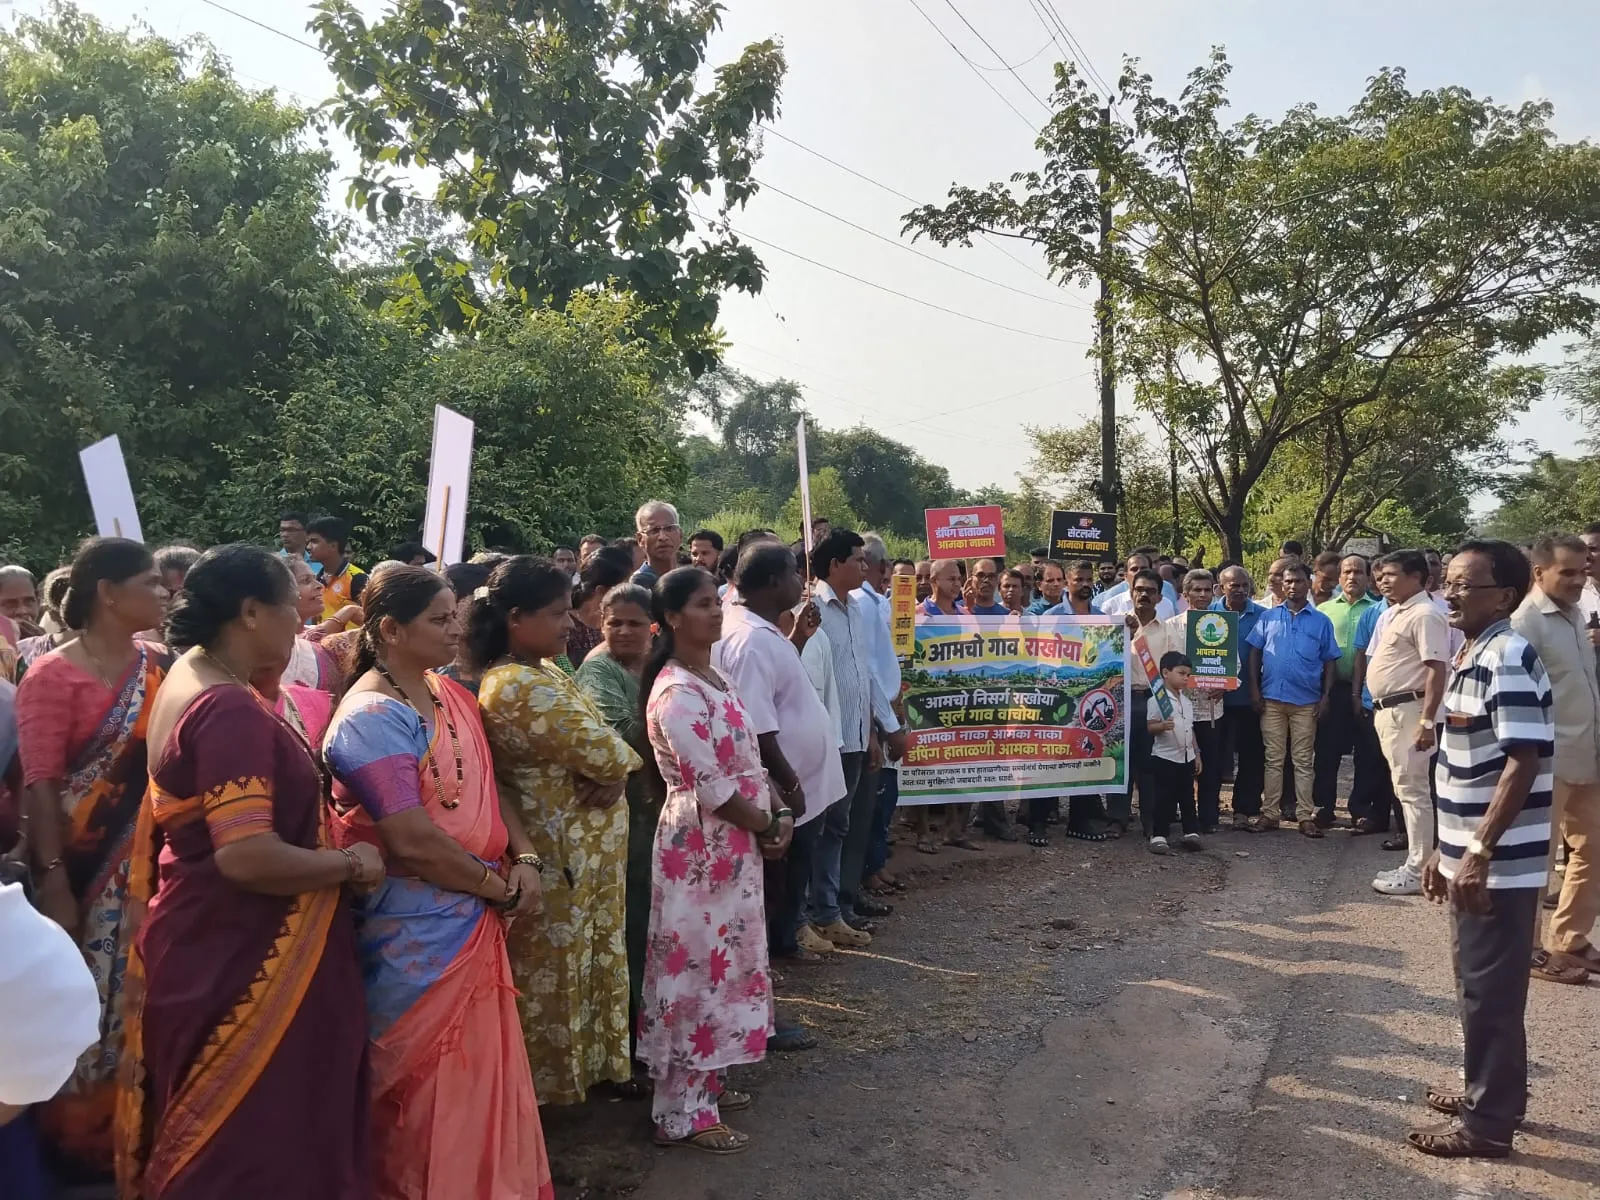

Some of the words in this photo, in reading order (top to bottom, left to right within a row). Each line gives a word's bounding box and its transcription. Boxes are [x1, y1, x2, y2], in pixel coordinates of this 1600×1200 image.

[1067, 526, 1101, 539] सेटलमेंट
[937, 540, 967, 549] आमका
[1056, 540, 1084, 550] आमका
[928, 632, 985, 662] आमचो
[987, 638, 1020, 656] गाव
[1024, 632, 1082, 661] राखोया
[973, 687, 1010, 706] निसर्ग
[968, 708, 993, 721] गाव
[997, 704, 1044, 721] वाचोया.
[917, 732, 956, 745] आमका
[959, 731, 990, 741] नाका
[992, 729, 1030, 740] आमका
[1033, 729, 1062, 740] नाका
[942, 740, 995, 759] हाताळणी
[998, 743, 1038, 756] आमका
[1041, 744, 1073, 755] नाका.
